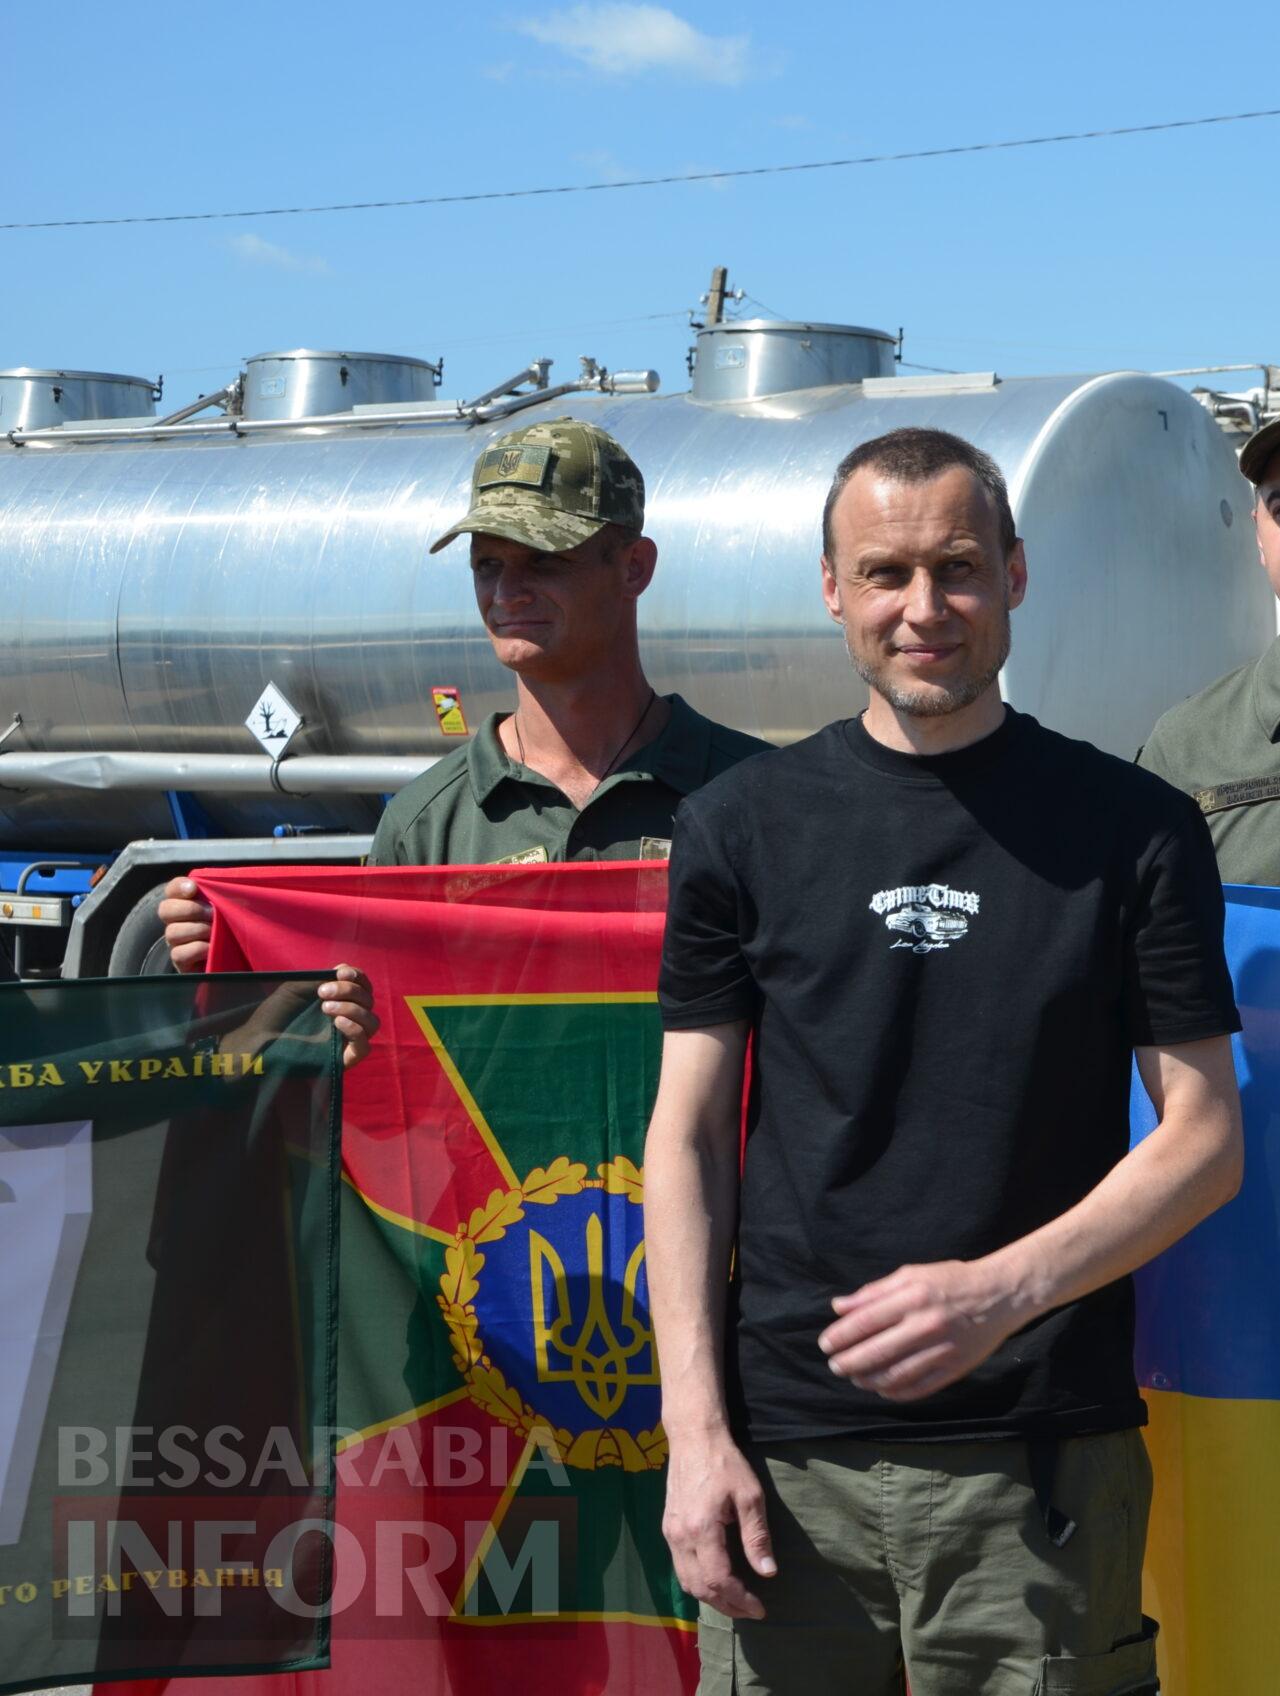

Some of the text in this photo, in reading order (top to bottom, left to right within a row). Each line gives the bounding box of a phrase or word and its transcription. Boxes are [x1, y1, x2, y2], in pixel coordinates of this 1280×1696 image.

[0, 1052, 265, 1088] БА УКРАЇНИ
[52, 1567, 286, 1600] РЕАГУВАННЯ
